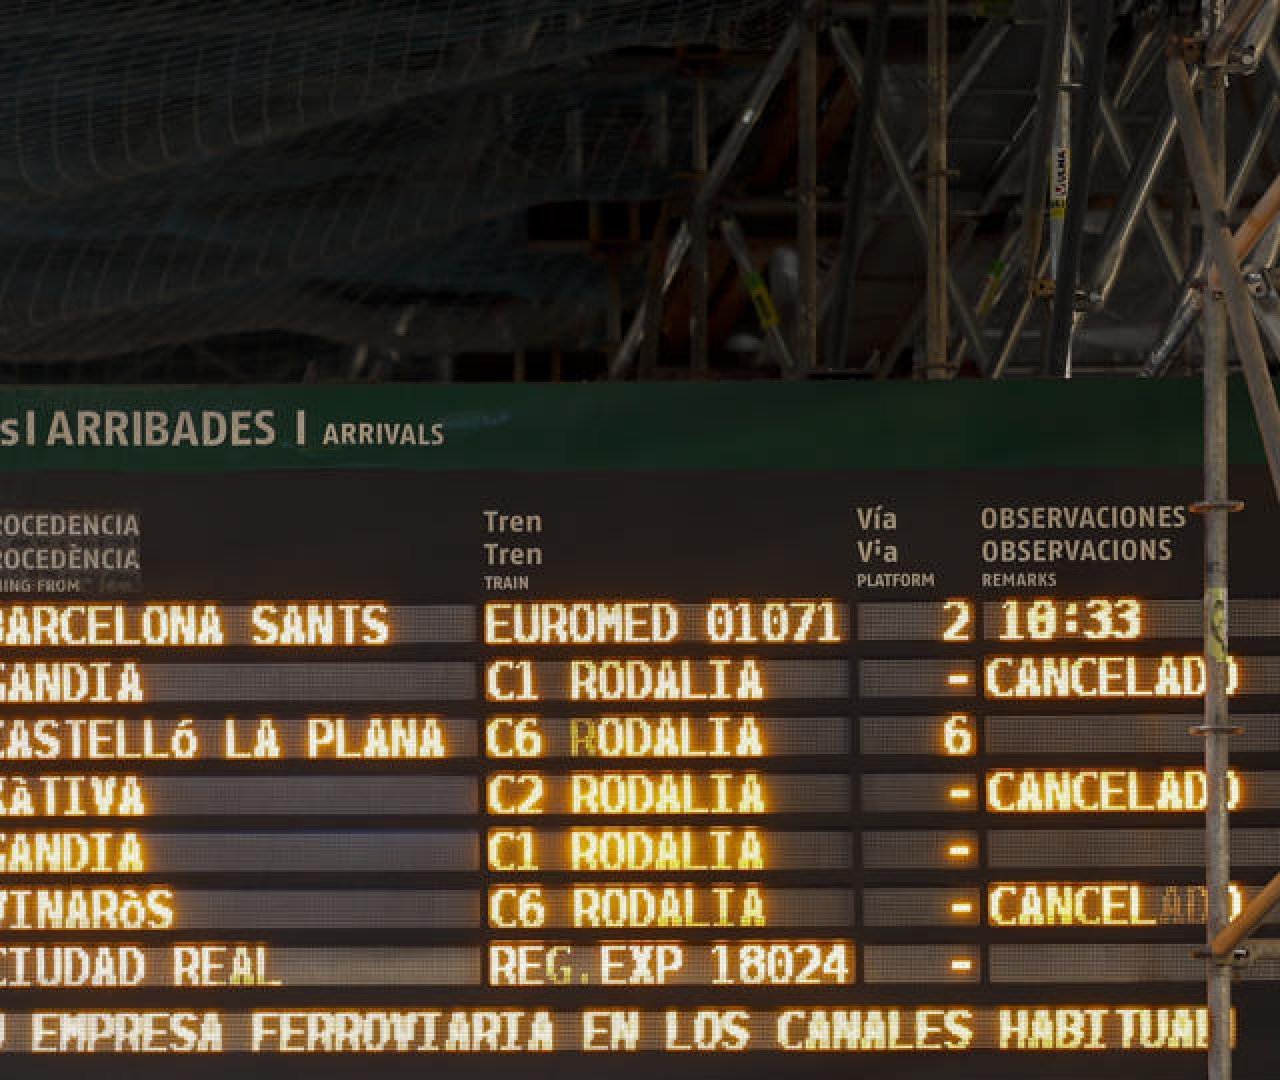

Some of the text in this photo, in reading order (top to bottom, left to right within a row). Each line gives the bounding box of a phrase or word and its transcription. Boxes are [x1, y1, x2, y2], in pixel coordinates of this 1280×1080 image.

[48, 410, 274, 446] ARRIBADES
[323, 424, 444, 444] ARRIVALS
[484, 512, 542, 532] Tren
[858, 506, 896, 530] Vía
[982, 506, 1186, 528] OBSERVACIONES
[484, 544, 542, 564] Tren
[982, 540, 1170, 562] OBSERVACIONS
[38, 580, 80, 592] FROM
[484, 576, 528, 590] TRAIN
[858, 574, 934, 586] PLATFORM
[982, 574, 1056, 586] REMARKS
[252, 606, 388, 644] SANTS
[486, 604, 678, 642] EUROMED
[708, 602, 840, 642] 01071
[944, 602, 970, 640] 2
[1000, 600, 1140, 640] 10:33
[488, 662, 538, 700] C1
[572, 660, 762, 700] RODALIA
[226, 720, 280, 758] LA
[308, 720, 444, 758] PLANA
[486, 718, 542, 756] C6
[571, 717, 762, 757] RODALIA
[944, 716, 972, 754] 6
[488, 776, 544, 814] C2
[572, 774, 764, 814] RODALIA
[488, 832, 538, 870] C1
[570, 830, 764, 870] RODALIA
[490, 888, 544, 928] C6
[574, 888, 765, 927] RODALIA
[173, 946, 280, 985] REAL
[712, 944, 848, 984] 18024
[32, 1010, 972, 1052] EMPRESA FERROVIARIA EN LOS CANALES
